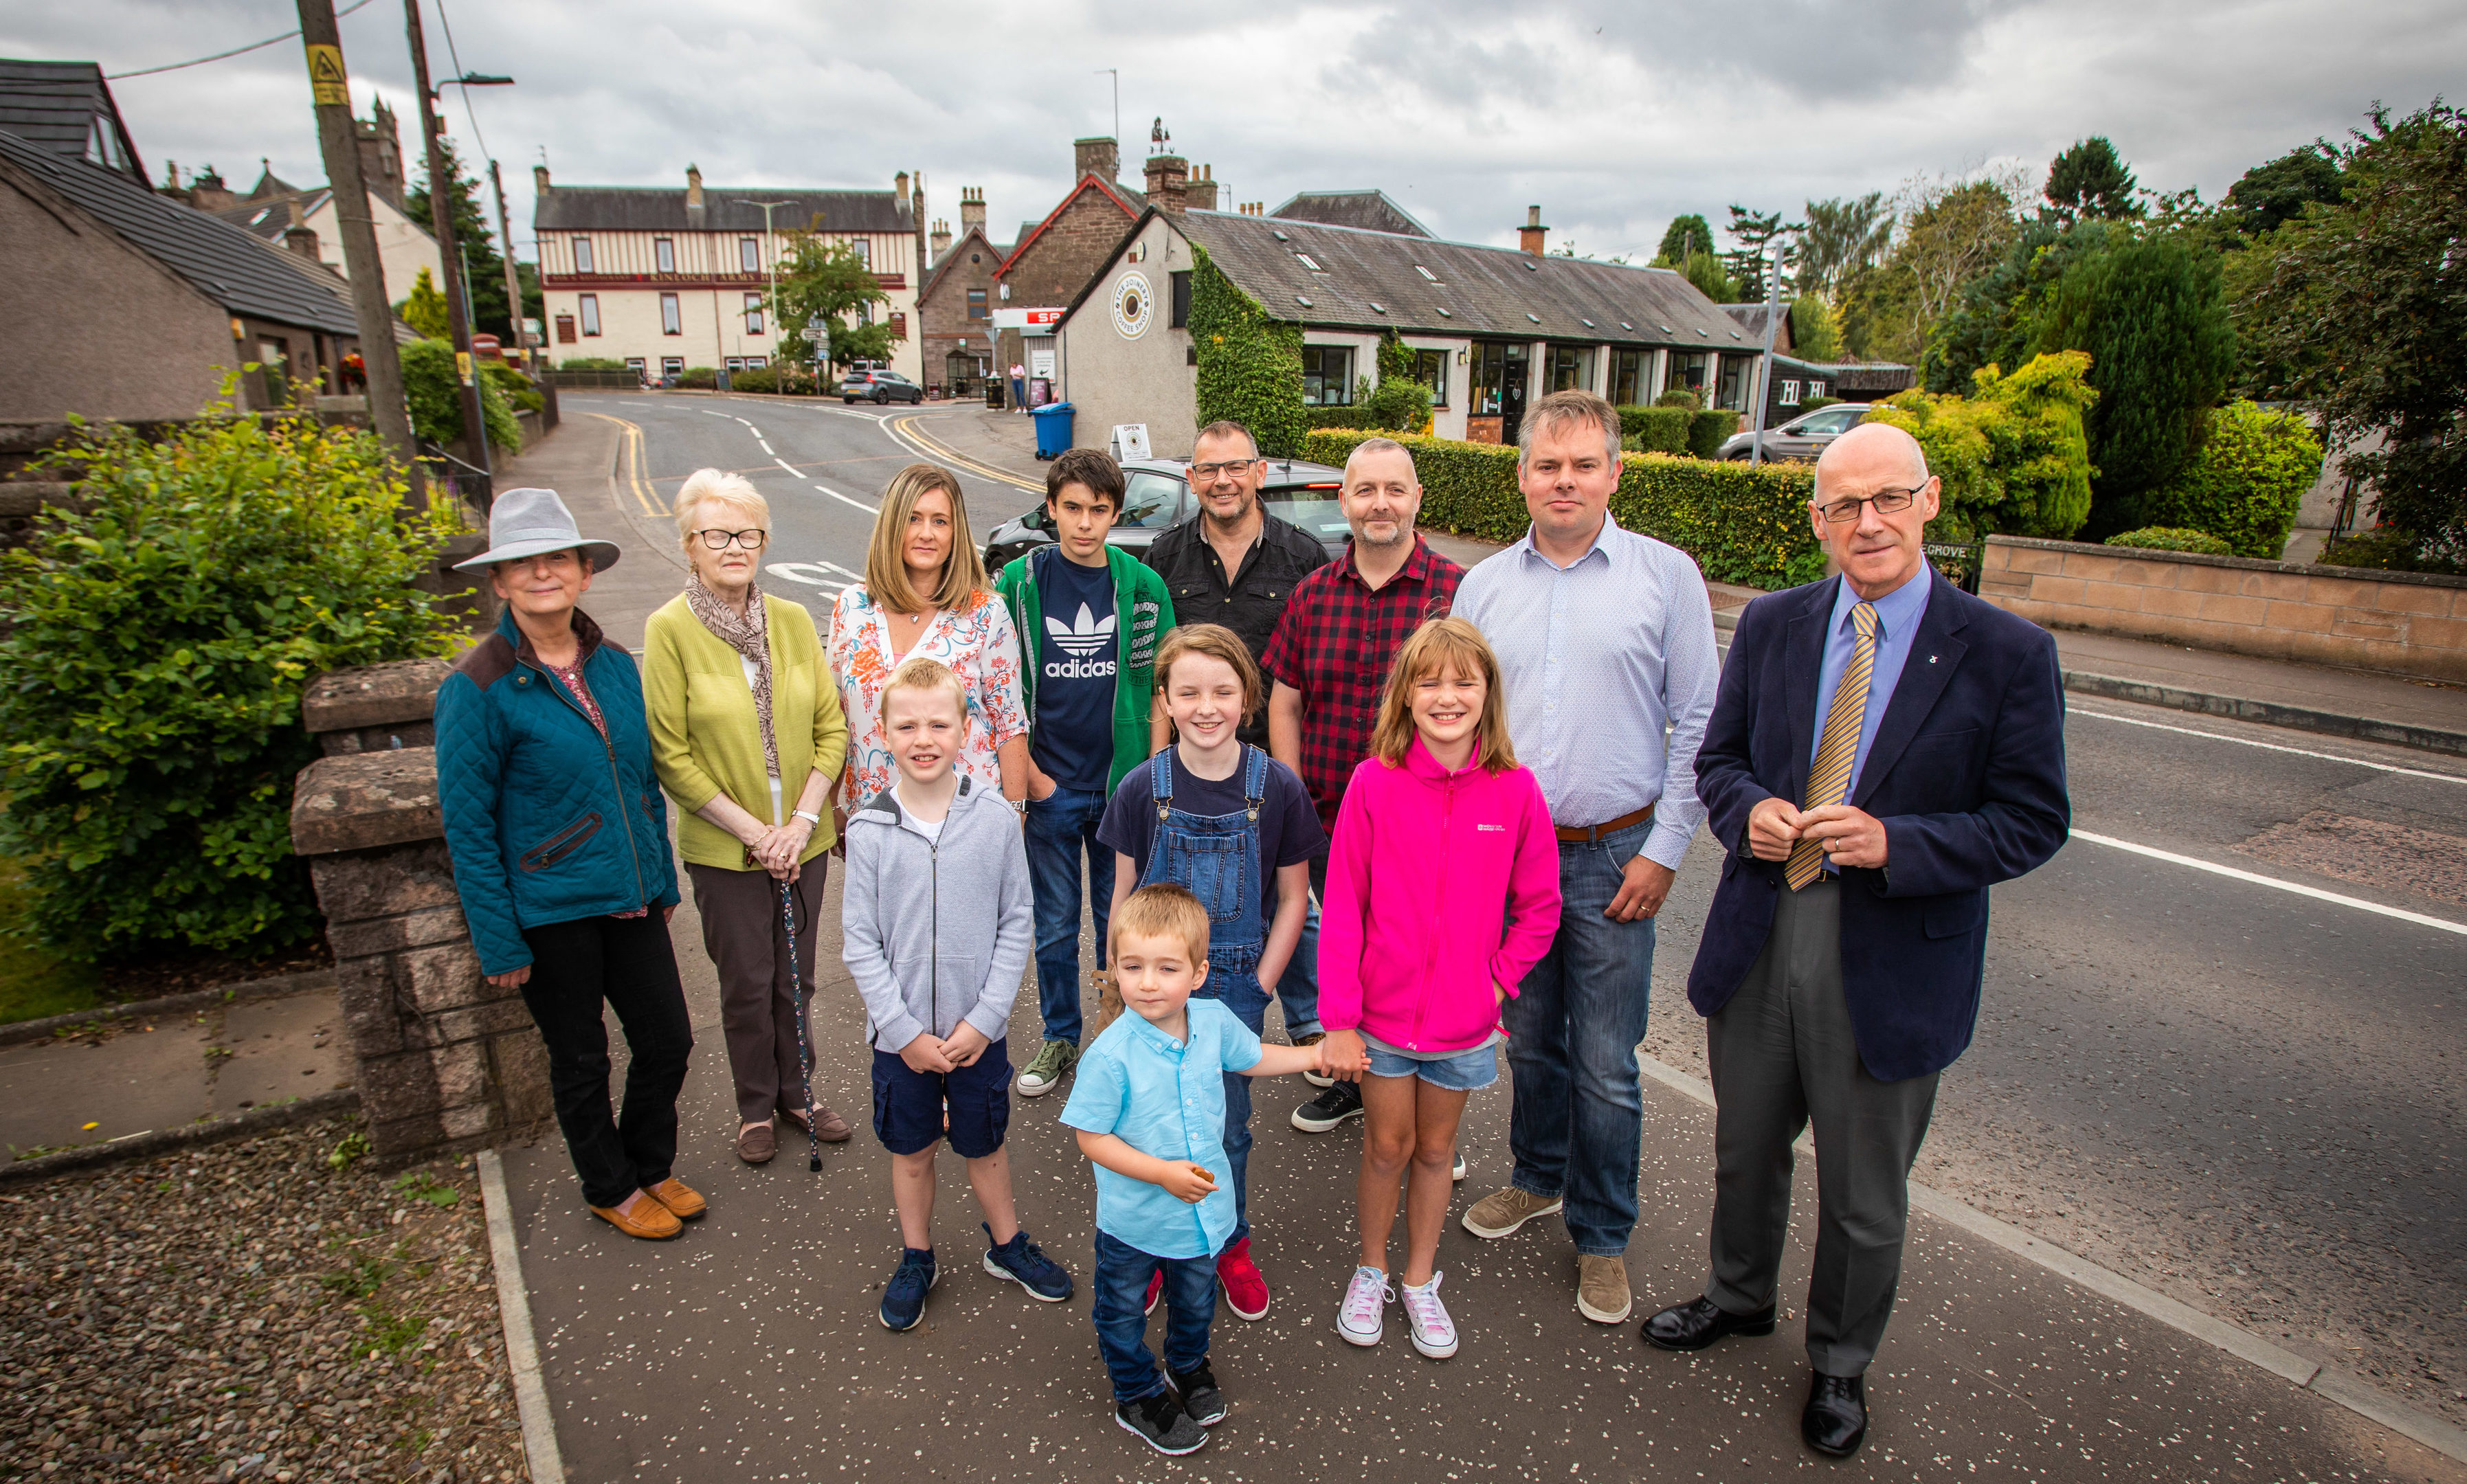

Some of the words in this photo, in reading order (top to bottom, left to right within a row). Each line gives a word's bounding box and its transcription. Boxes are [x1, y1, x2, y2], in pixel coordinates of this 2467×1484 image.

[649, 273, 711, 282] KINLOCH
[1116, 284, 1125, 300] THE
[1126, 279, 1148, 299] JOINERY
[1038, 313, 1060, 322] SP
[1116, 311, 1134, 332] COFFEE
[1135, 310, 1148, 330] SHOP
[1921, 543, 1967, 558] EGROVE
[1045, 658, 1116, 678] adidas
